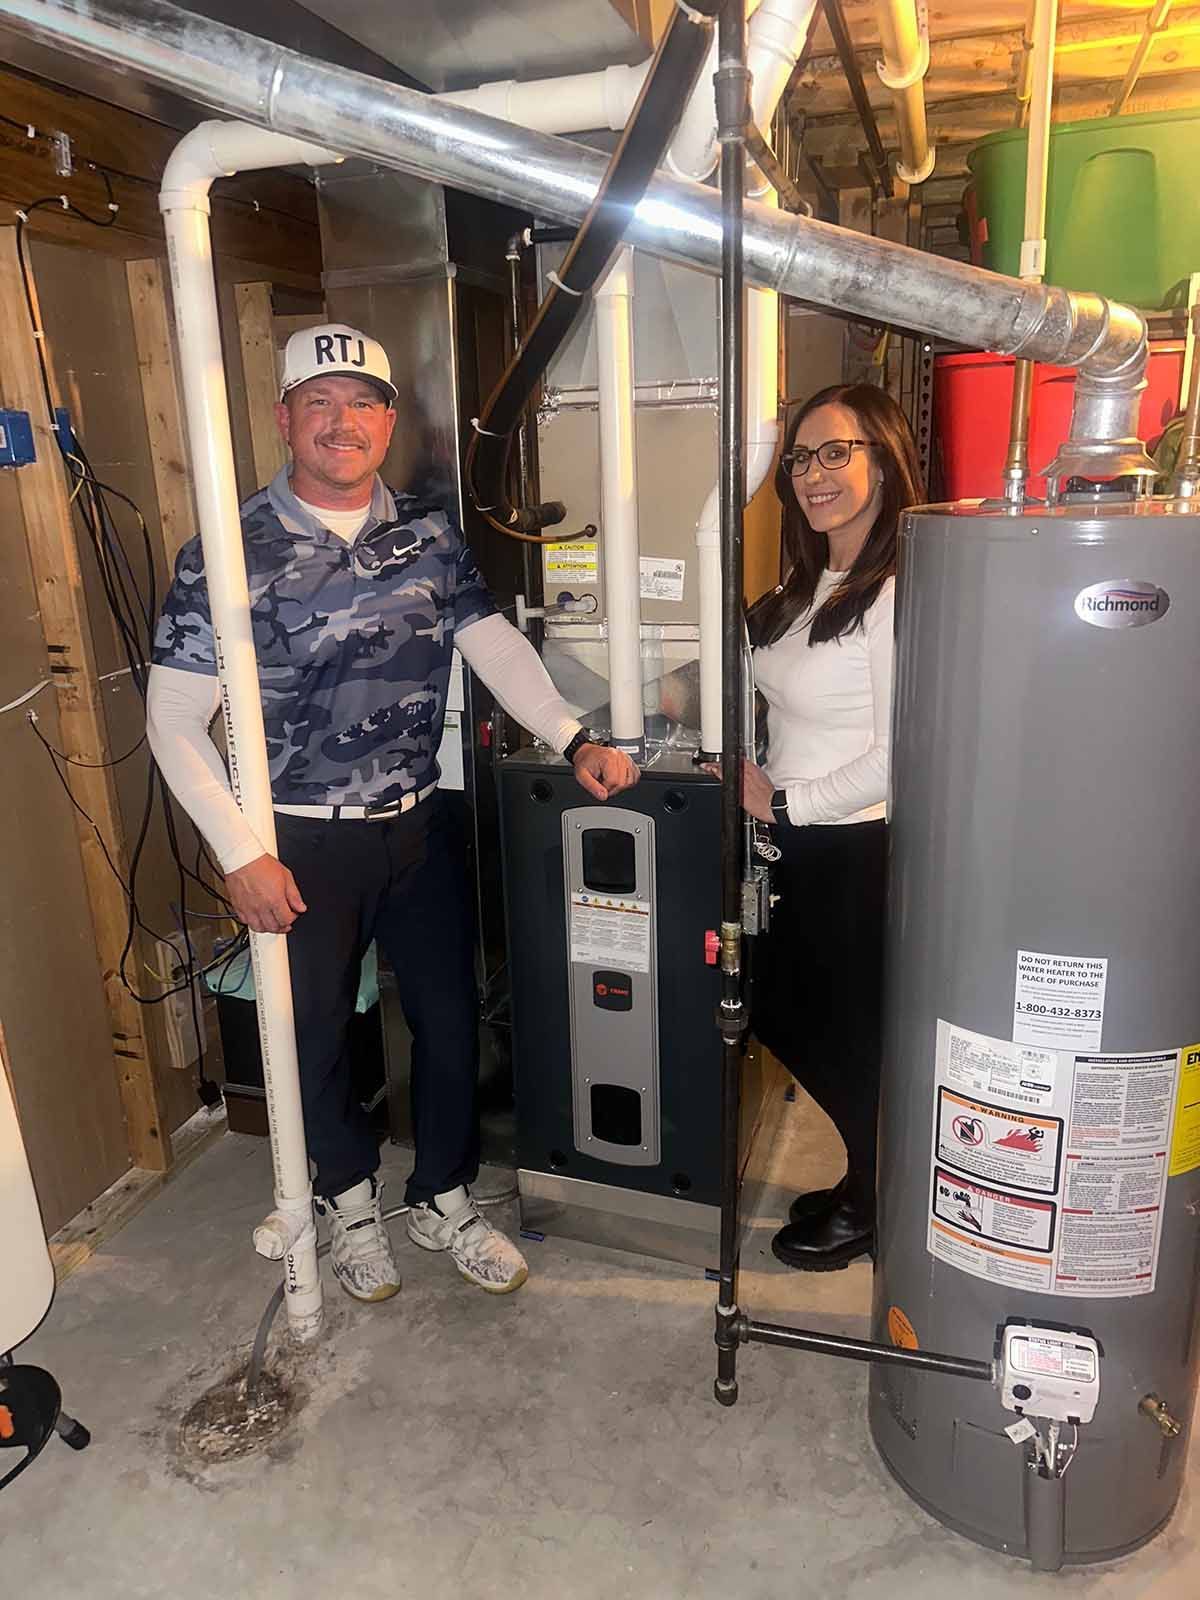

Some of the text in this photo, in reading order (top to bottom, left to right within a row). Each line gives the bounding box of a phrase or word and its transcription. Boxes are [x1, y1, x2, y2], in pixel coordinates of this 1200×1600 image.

[314, 333, 366, 367] RTJ
[1081, 594, 1160, 612] Richmond
[222, 684, 245, 814] MANUFACTU
[1018, 964, 1044, 974] WATER
[1046, 968, 1075, 977] HEATER
[1021, 955, 1103, 970] DO NOT RETURN THIS
[1022, 974, 1045, 983] PLACE
[1059, 979, 1099, 988] PURCHASE
[1016, 1001, 1102, 1019] 1-800-432-8373
[980, 1106, 1024, 1124] WARNING
[975, 1187, 1011, 1203] DANGER
